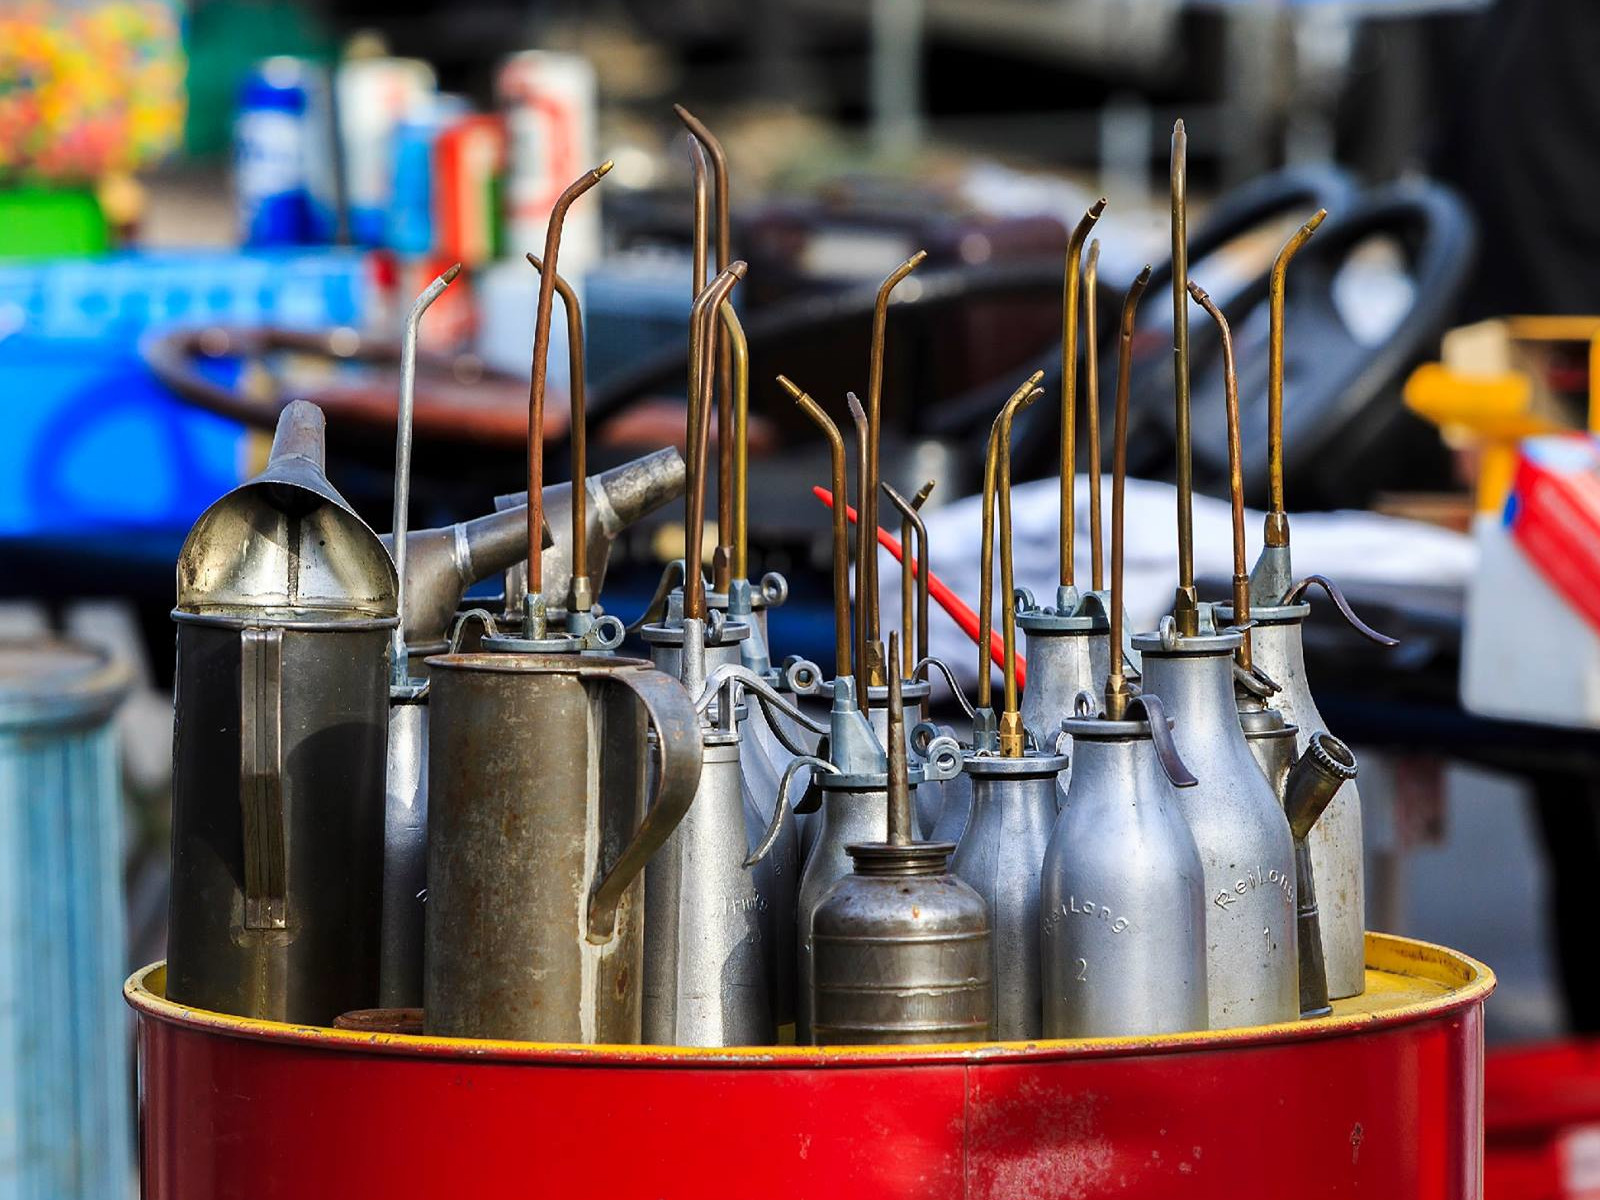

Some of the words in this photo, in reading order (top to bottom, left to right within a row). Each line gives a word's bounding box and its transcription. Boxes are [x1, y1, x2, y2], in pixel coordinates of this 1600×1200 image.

[1213, 865, 1294, 912] ReiLong
[1263, 926, 1271, 953] 1
[1075, 957, 1088, 982] 2
